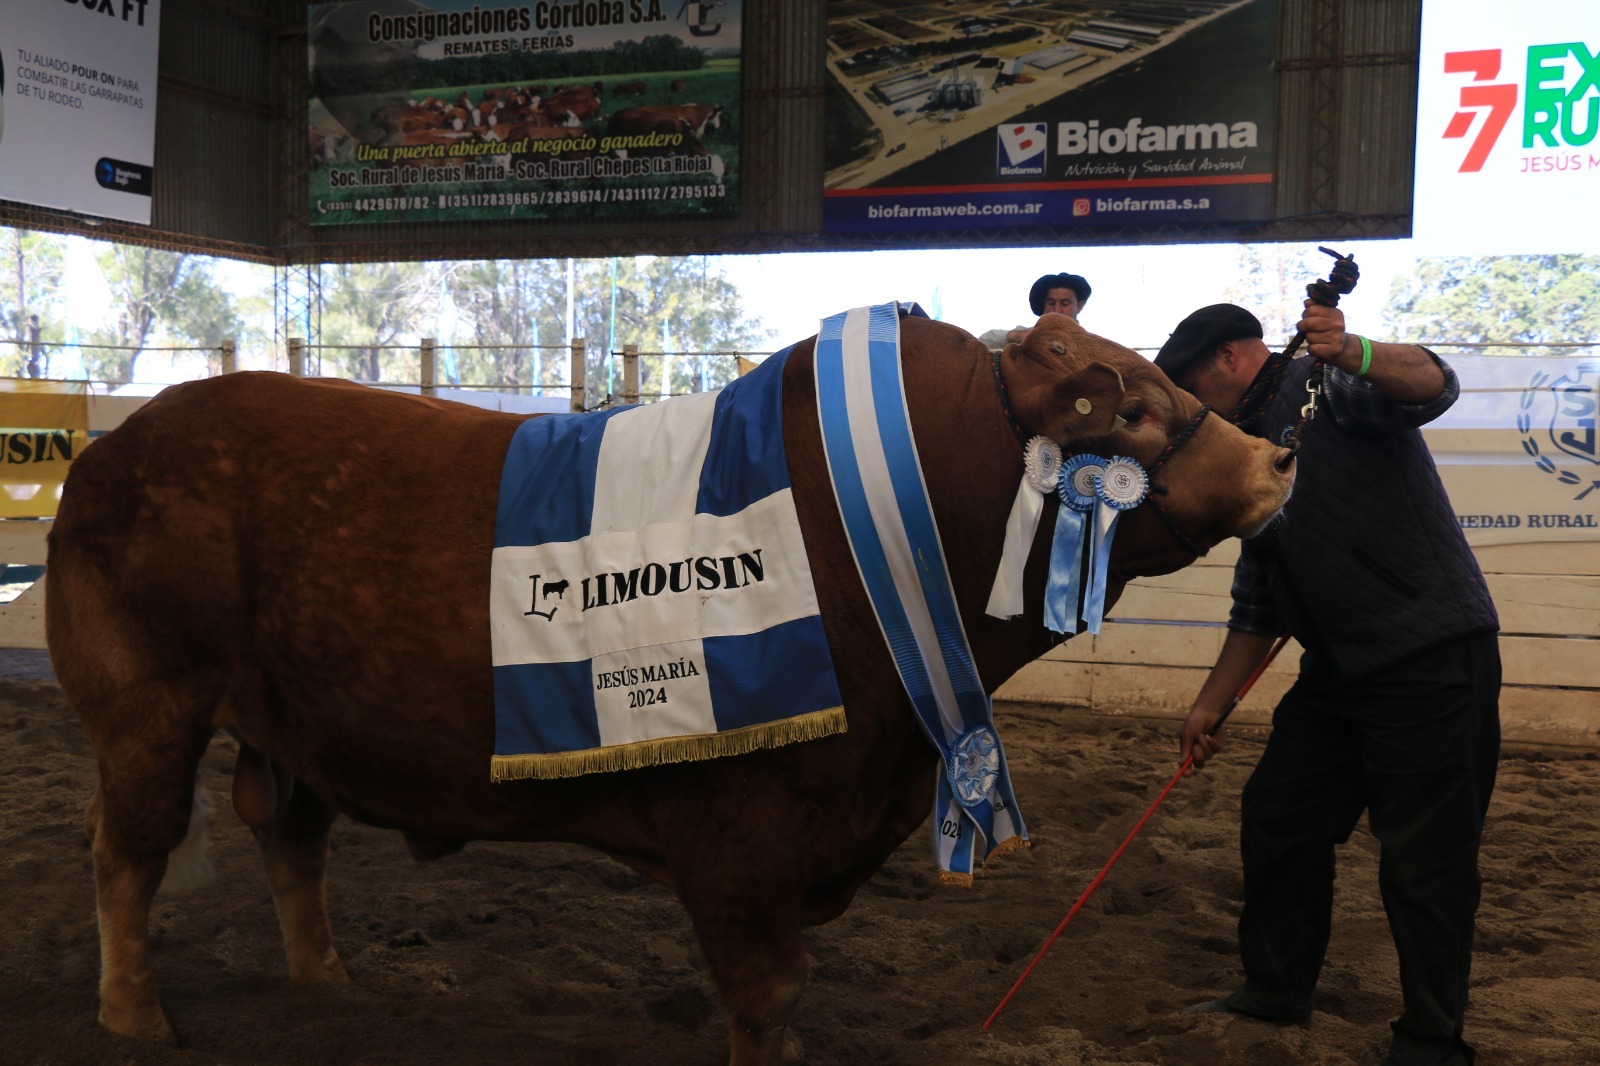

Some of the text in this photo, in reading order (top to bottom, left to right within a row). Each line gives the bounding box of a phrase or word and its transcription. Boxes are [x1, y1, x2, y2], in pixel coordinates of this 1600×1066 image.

[369, 0, 667, 42] Consignaciones Córdoba S.A.
[444, 42, 509, 56] REMATES
[522, 35, 574, 50] FERIAS
[18, 49, 139, 92] TU ALIADO POUR ON PARA
[17, 66, 144, 109] COMBATIR LAS GARRAPATAS
[17, 83, 84, 110] DE TU RODEO.
[357, 131, 683, 163] Una puerta abierta al negocio ganadero
[1057, 118, 1258, 155] Biofarma
[330, 170, 359, 187] Soc.
[362, 166, 399, 185] Rural
[401, 166, 418, 184] de
[517, 160, 549, 180] Soc.
[551, 156, 591, 179] Rural
[593, 154, 650, 178] Chepes
[653, 156, 671, 174] (La
[674, 155, 713, 174] Rioja)
[1000, 167, 1042, 175] Biofarma
[1064, 155, 1247, 181] Nutrición y Sanidad Animal
[1520, 151, 1581, 173] JESÚS
[868, 202, 1043, 219] biofarmaweb.com.ar
[1096, 197, 1210, 213] biofarma.s.a
[1458, 515, 1598, 528] IEDAD RURAL
[581, 549, 765, 612] LIMOUSIN
[597, 658, 700, 691] JESÚS MARÍA
[627, 687, 667, 708] 2024
